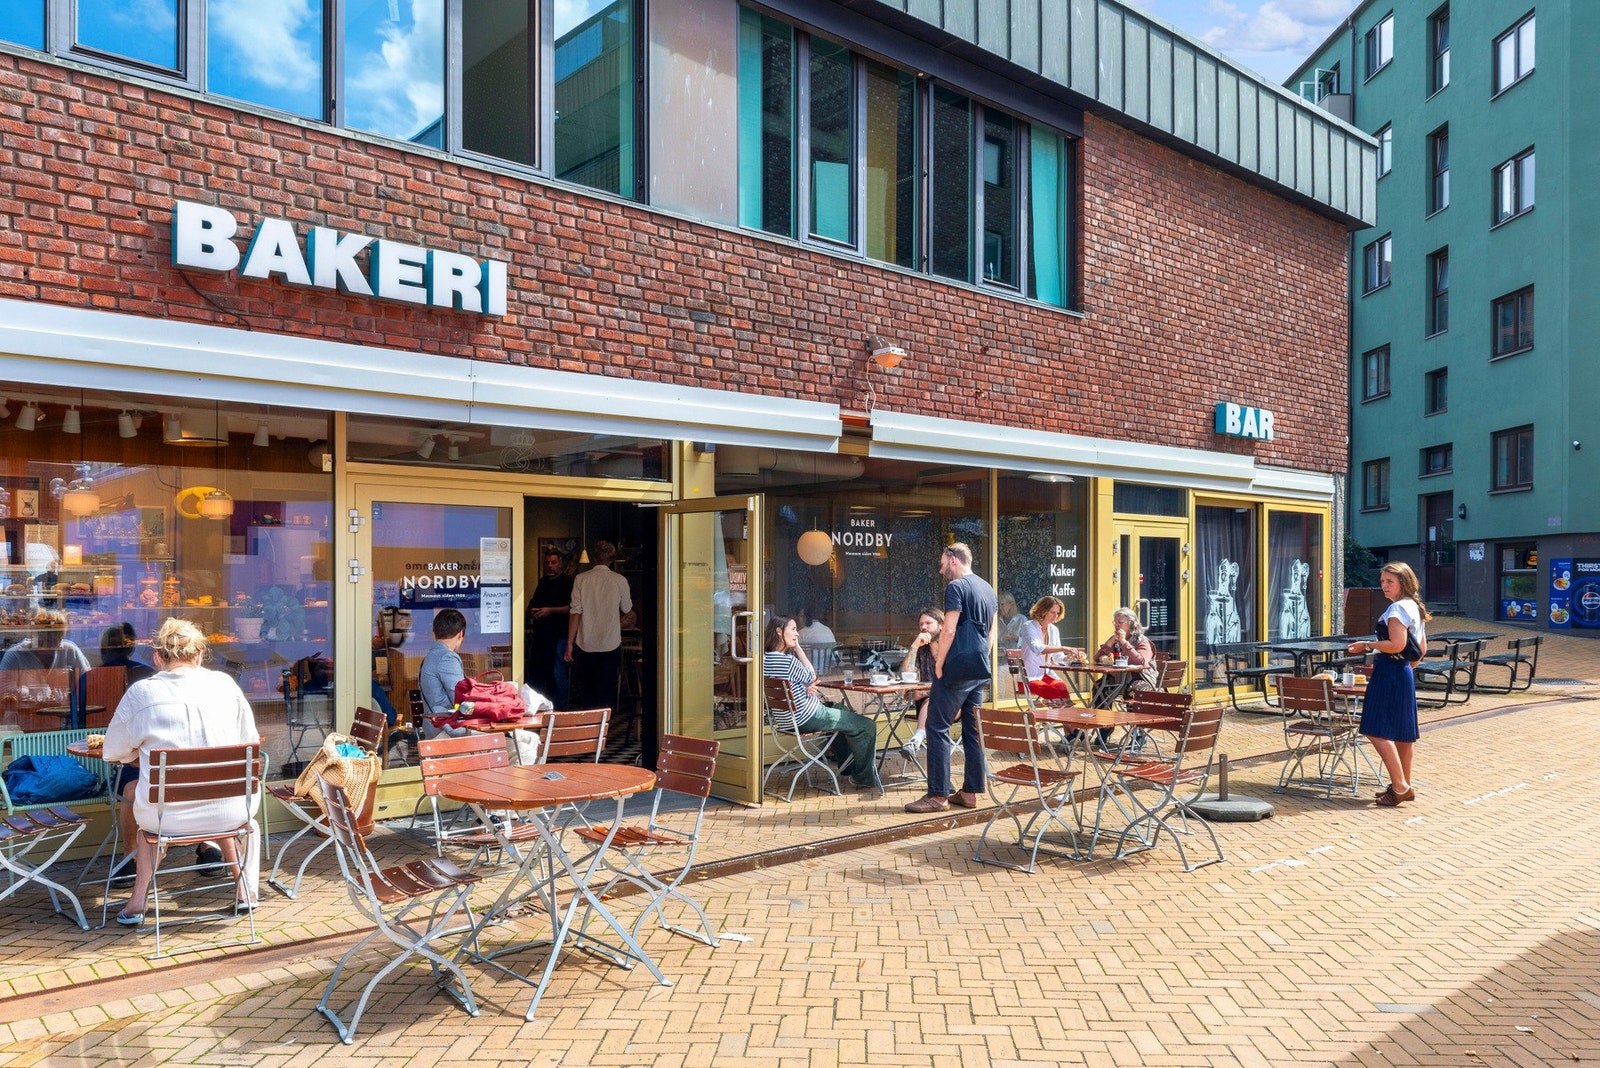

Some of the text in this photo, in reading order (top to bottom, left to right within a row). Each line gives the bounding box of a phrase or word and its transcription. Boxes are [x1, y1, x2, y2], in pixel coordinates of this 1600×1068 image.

[173, 200, 507, 316] BAKERI
[1221, 402, 1275, 440] BAR
[850, 519, 875, 527] BAKER
[831, 532, 893, 547] NORDBY
[1056, 545, 1077, 558] Brød
[427, 562, 459, 571] BAKER
[1050, 564, 1076, 577] Kaker
[403, 575, 481, 590] NORDBY
[1052, 583, 1076, 596] Kaffe
